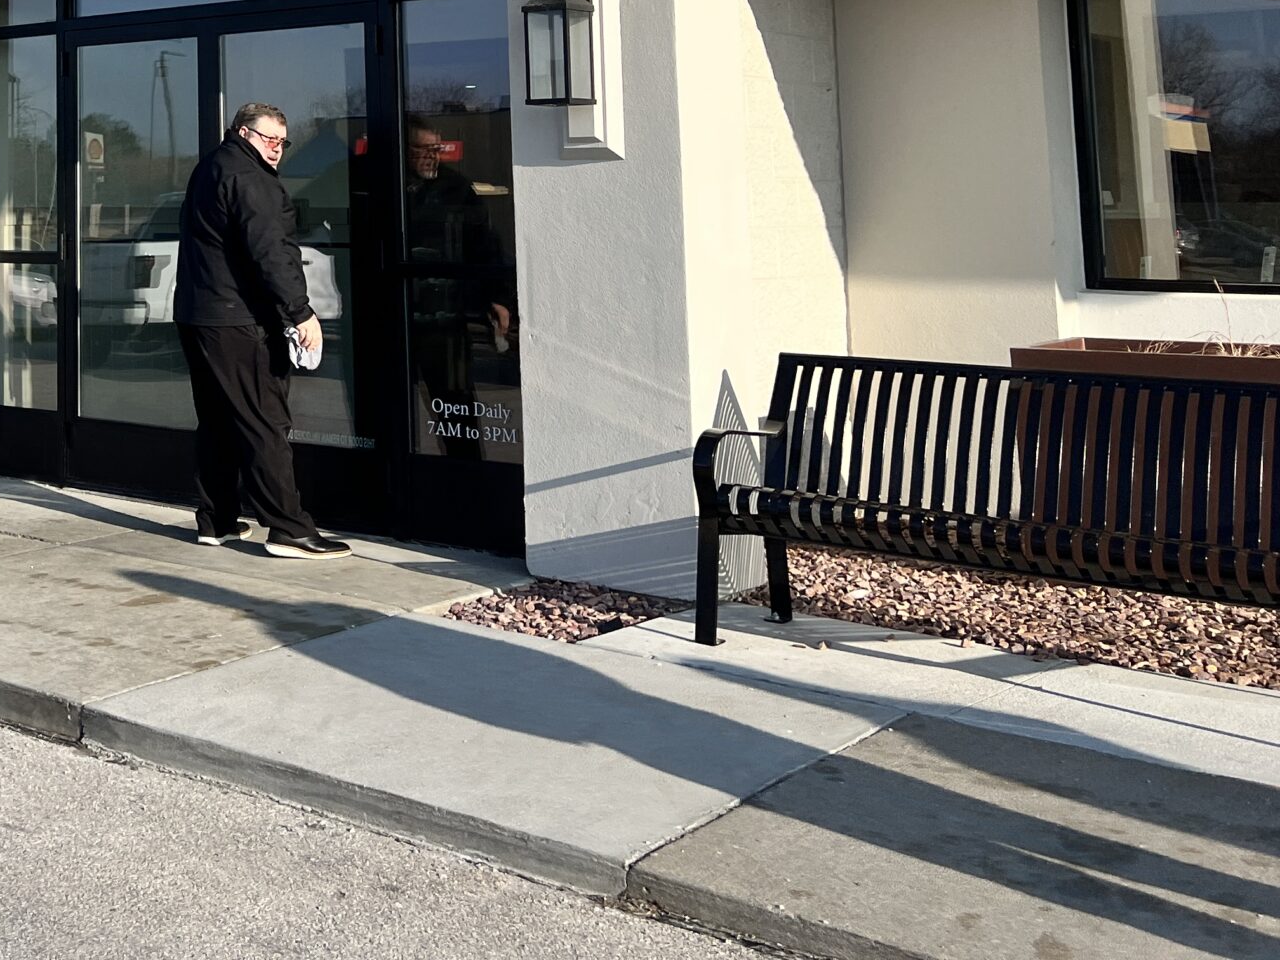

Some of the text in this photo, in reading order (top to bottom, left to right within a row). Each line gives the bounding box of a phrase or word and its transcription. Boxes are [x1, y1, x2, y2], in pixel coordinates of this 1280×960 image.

[431, 398, 512, 425] Open Daily
[427, 420, 518, 444] 7AM to 3PM
